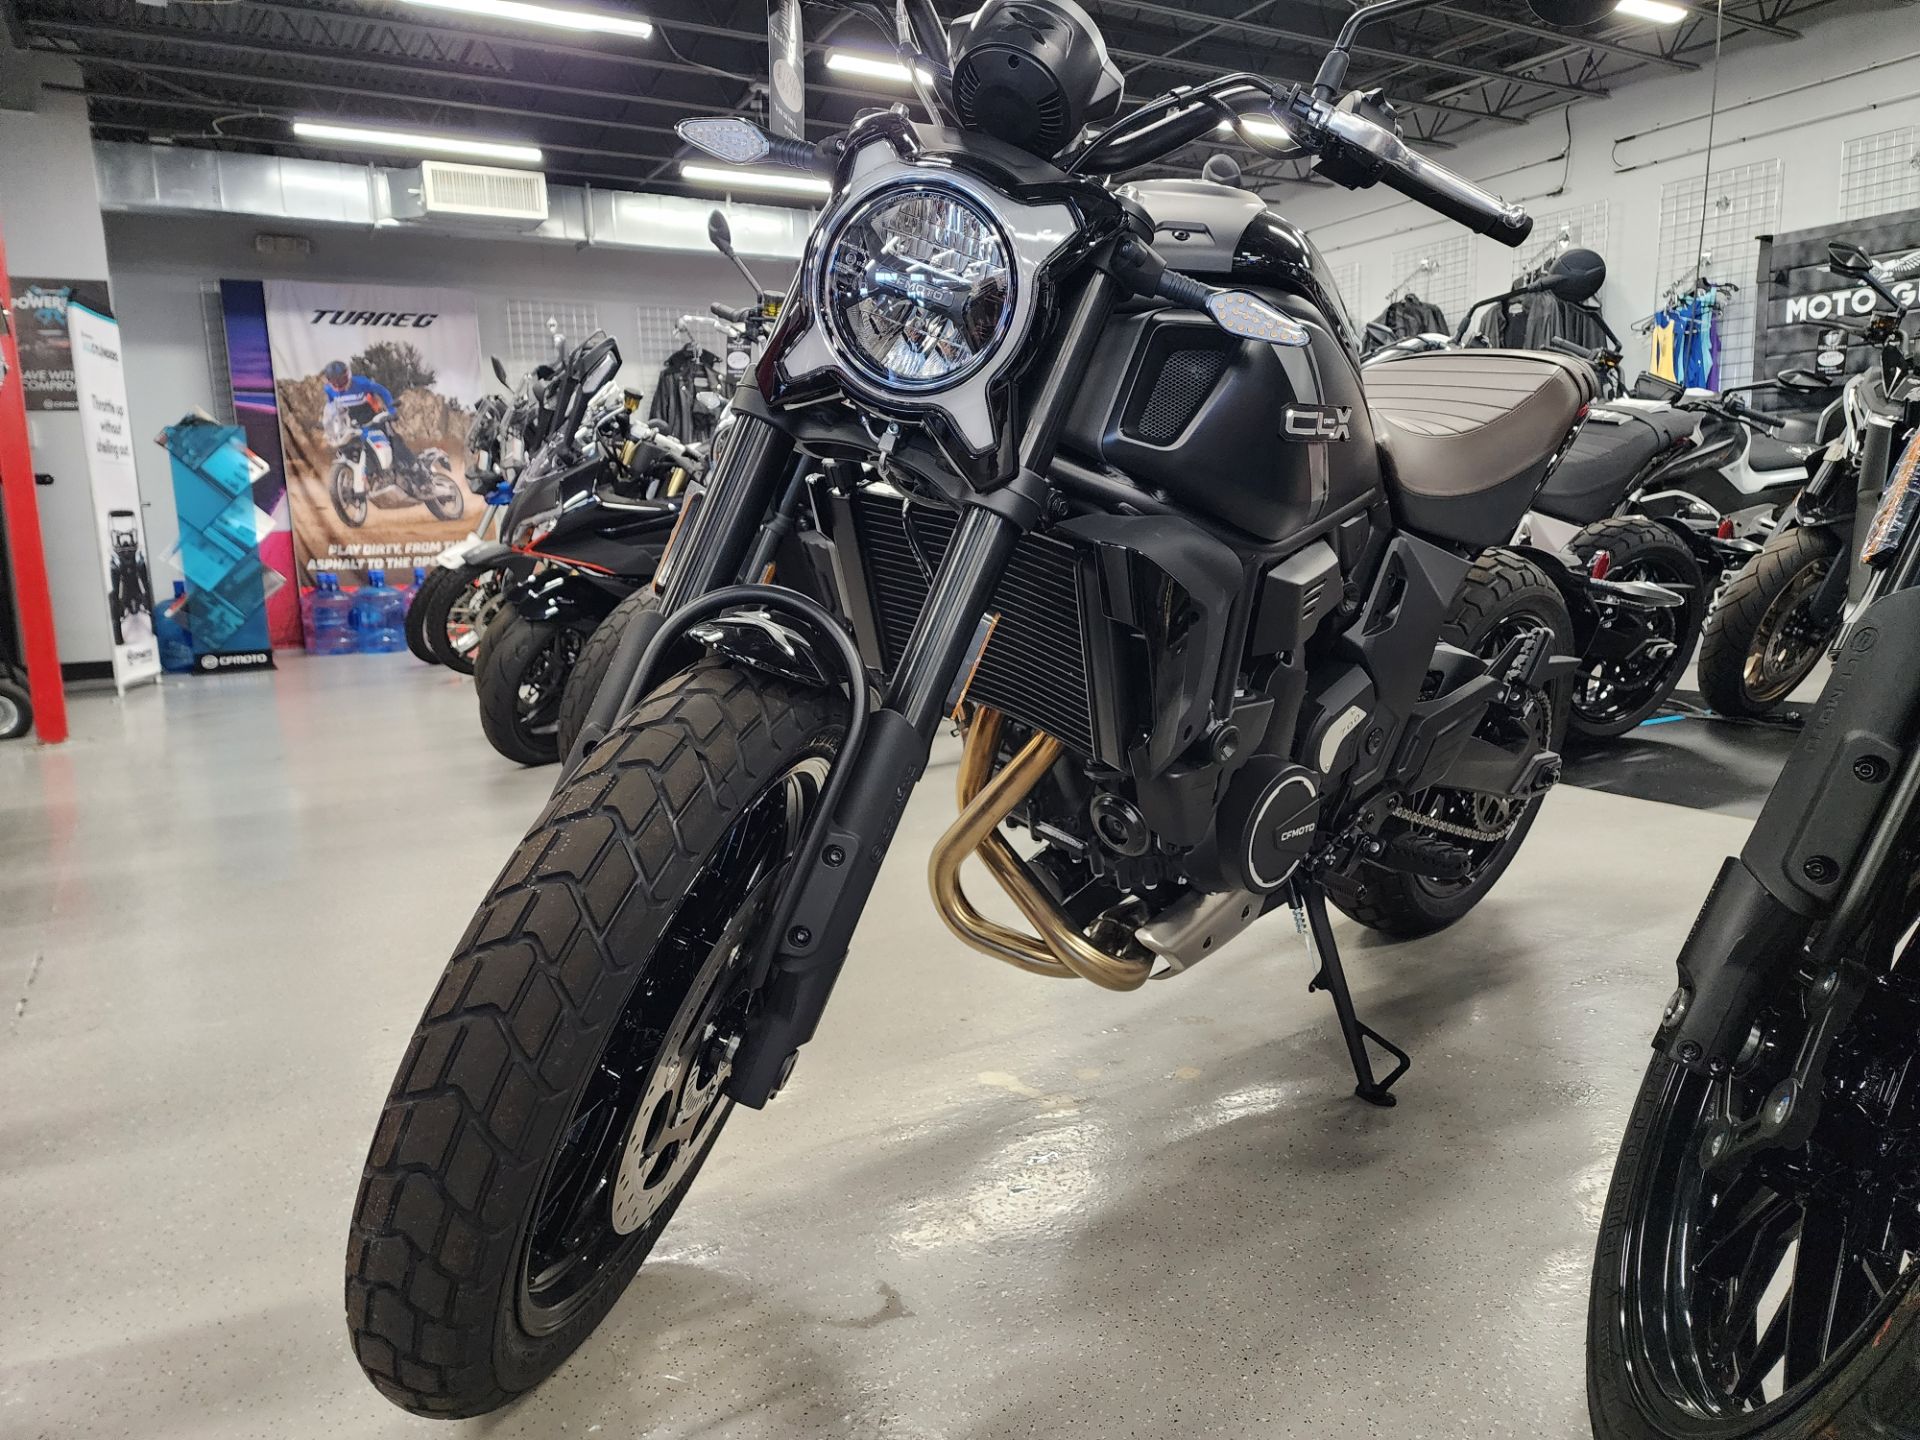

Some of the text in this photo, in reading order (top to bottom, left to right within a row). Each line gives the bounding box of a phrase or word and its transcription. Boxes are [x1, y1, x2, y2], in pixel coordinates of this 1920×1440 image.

[1786, 282, 1920, 324] MOTO G
[310, 309, 438, 328] TUAREG
[328, 544, 362, 556] PLAY
[405, 541, 442, 554] FROM
[307, 556, 438, 570] ASPHALT TO THE OPE
[220, 653, 267, 666] CFMOTO
[1281, 822, 1315, 841] CFMOTO
